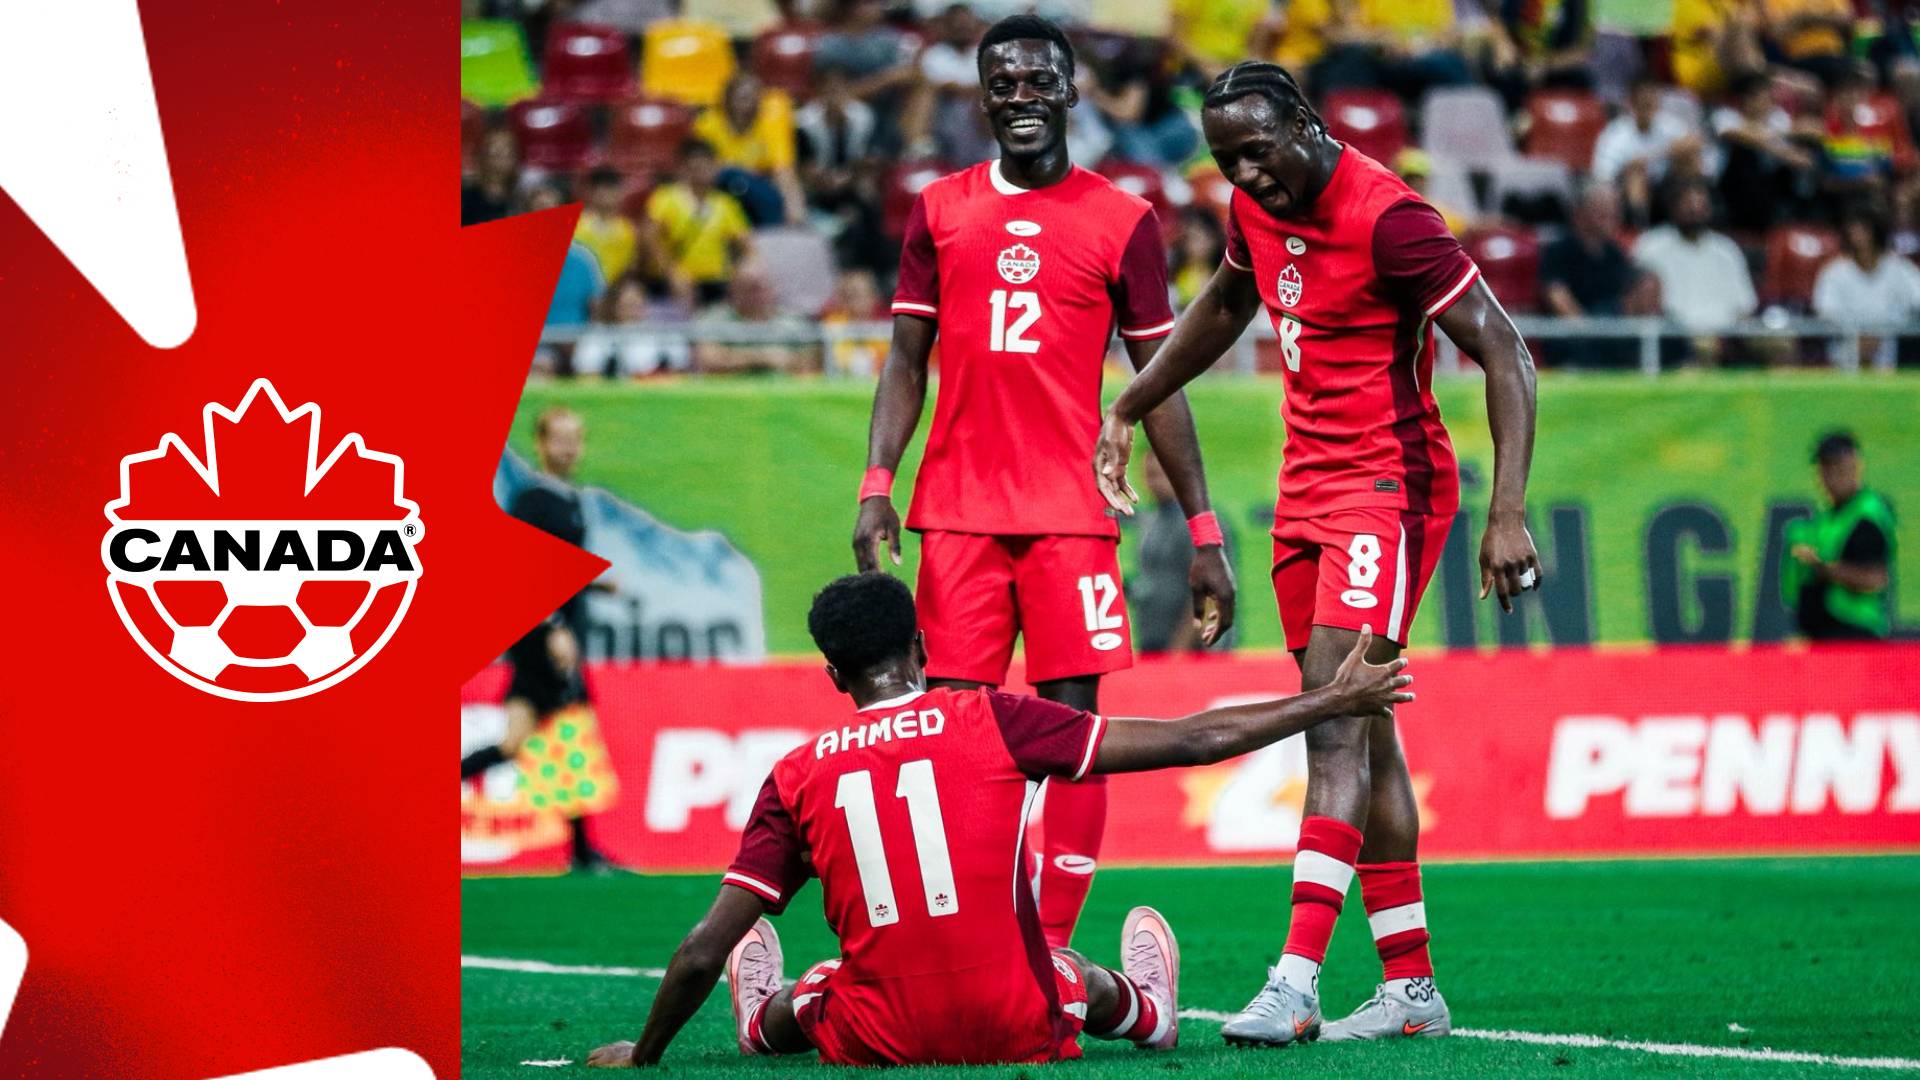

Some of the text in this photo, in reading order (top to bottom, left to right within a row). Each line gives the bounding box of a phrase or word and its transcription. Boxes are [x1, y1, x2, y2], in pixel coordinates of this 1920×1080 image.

[999, 260, 1037, 269] CANADA
[1279, 280, 1300, 292] CANADA
[989, 289, 1043, 354] 12
[1279, 312, 1302, 373] 8
[1346, 533, 1383, 589] 8
[1077, 573, 1124, 632] 12
[814, 707, 946, 760] AHMED
[834, 758, 960, 929] 11
